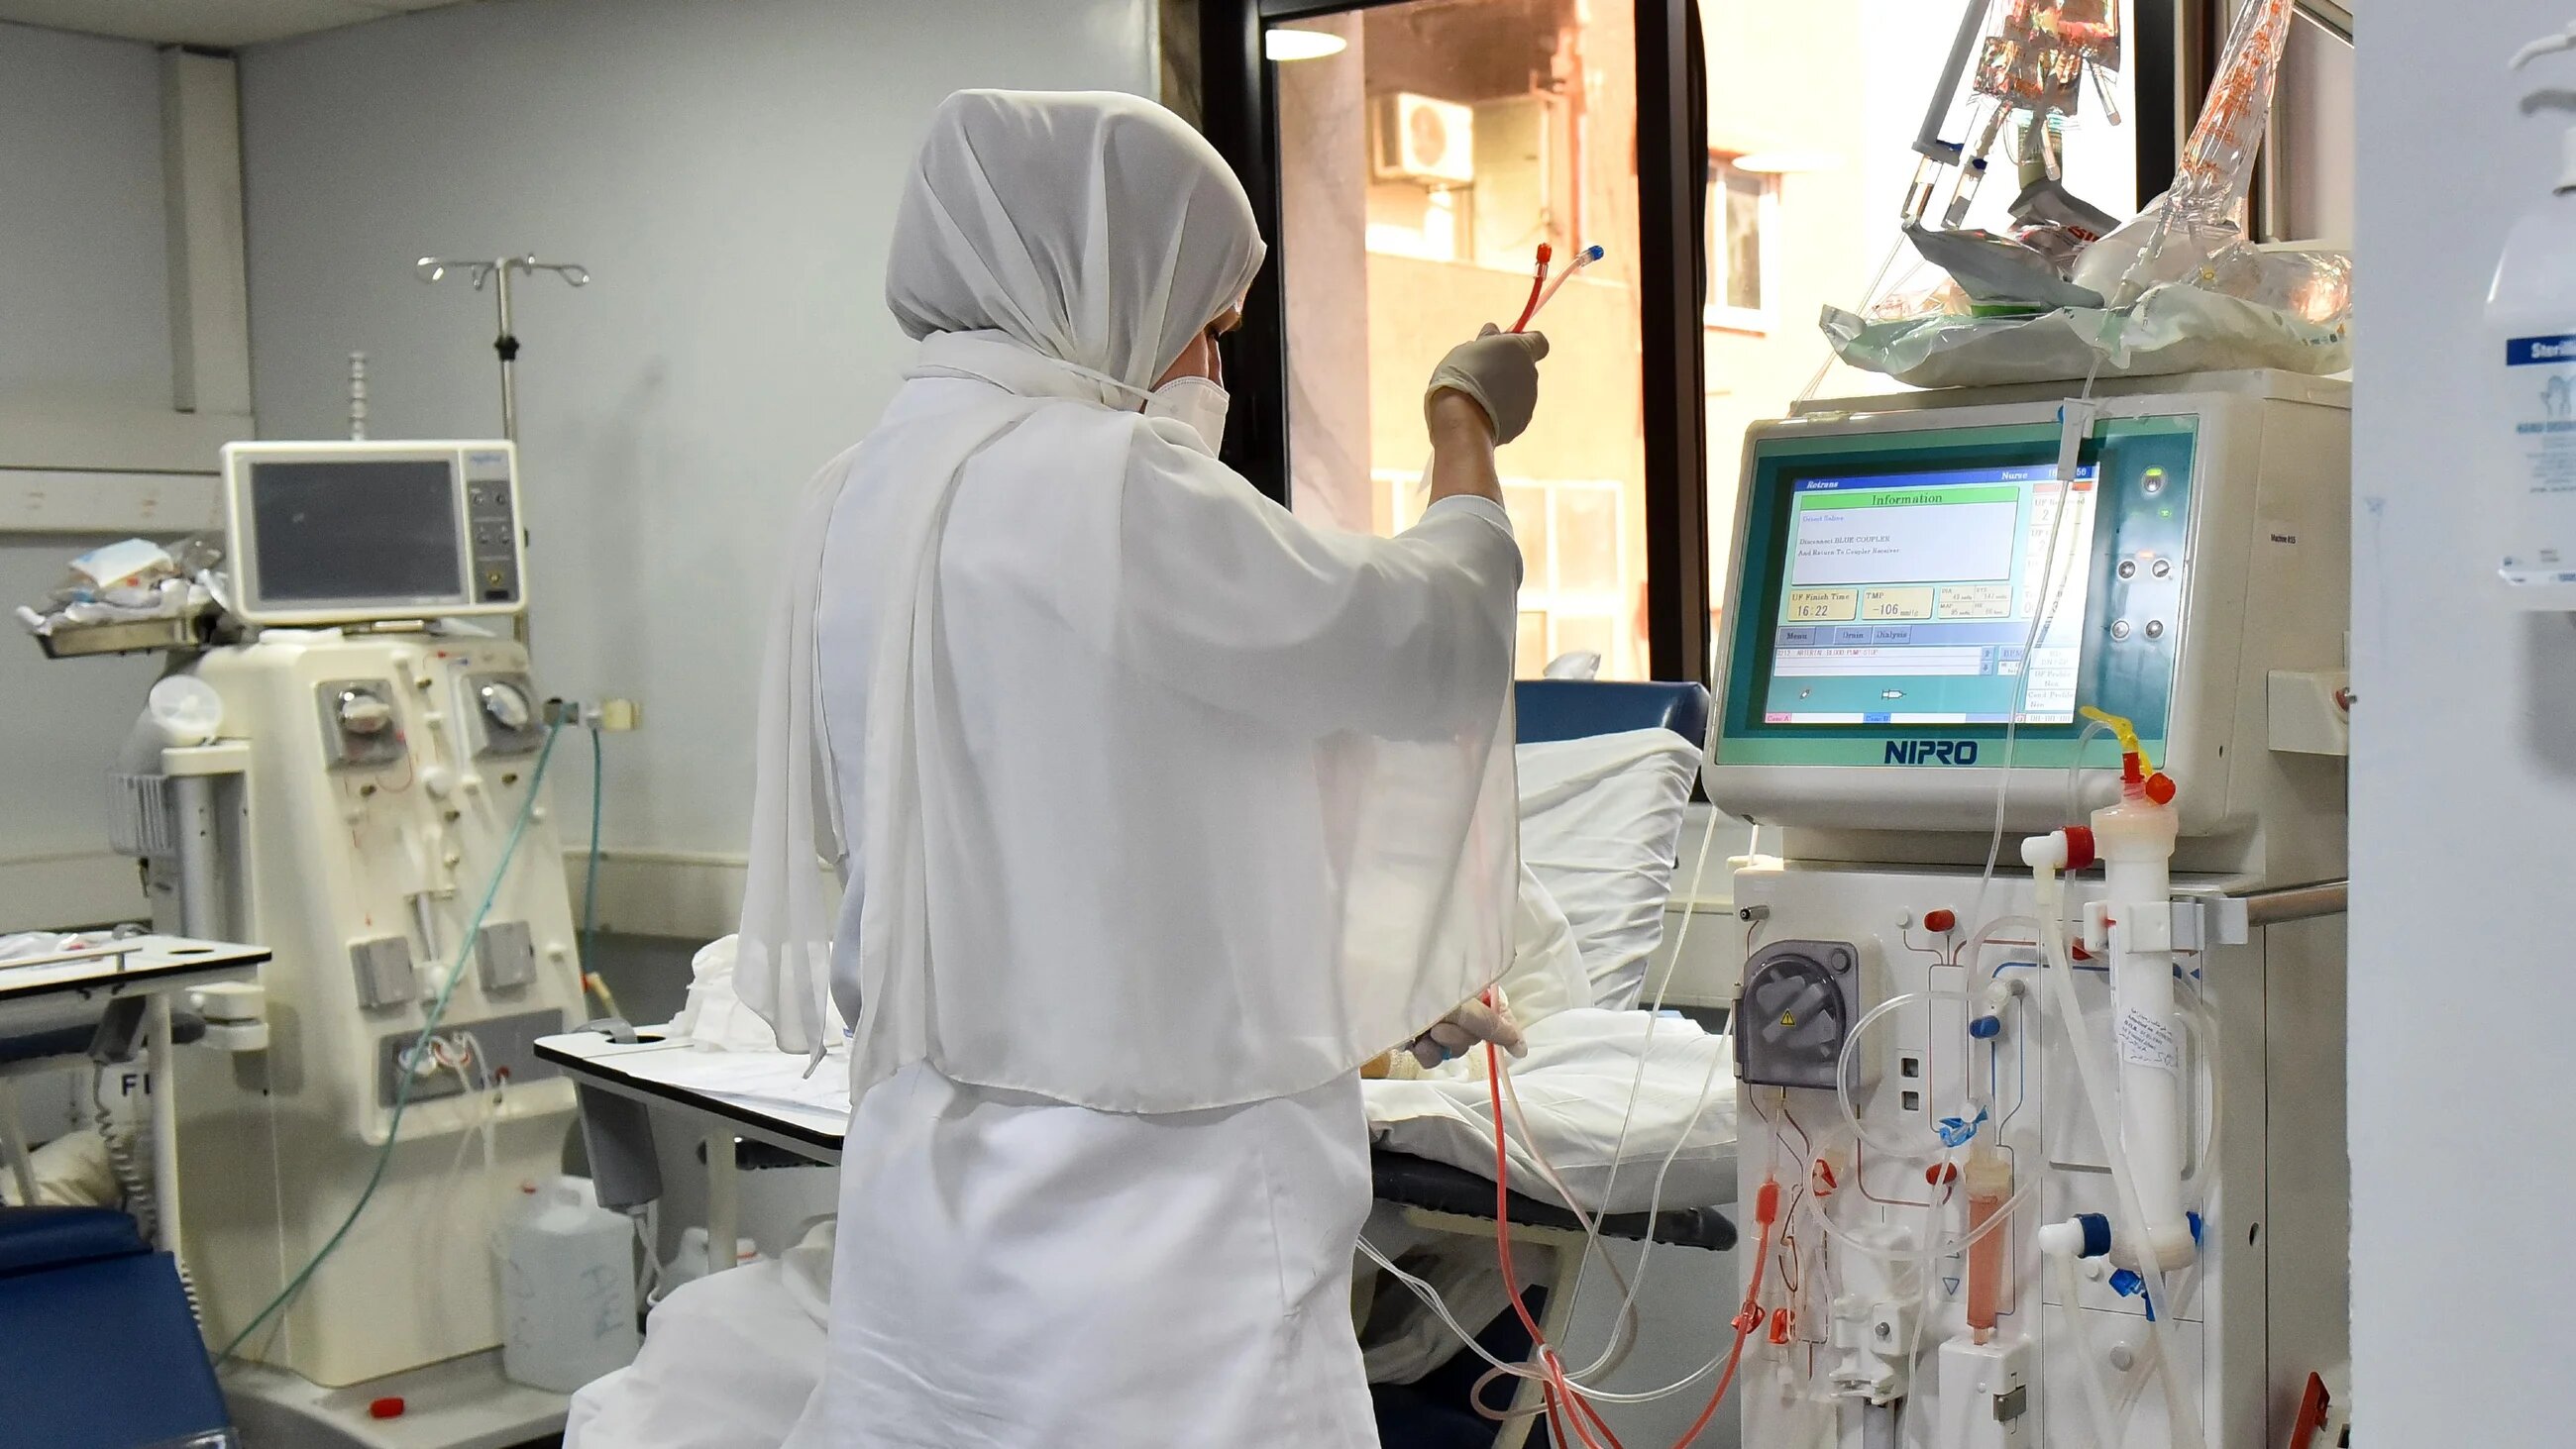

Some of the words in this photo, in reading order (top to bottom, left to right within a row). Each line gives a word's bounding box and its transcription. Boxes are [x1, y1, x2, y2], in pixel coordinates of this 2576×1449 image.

[1806, 480, 1839, 489] Retrans
[1872, 494, 1943, 506] Information
[1805, 592, 1829, 601] Finish
[1831, 592, 1850, 601] Time
[1866, 591, 1884, 600] TMP
[1797, 605, 1828, 617] 16:22
[1873, 603, 1898, 616] -106
[1877, 630, 1907, 640] Dialysis
[1884, 741, 1978, 765] NIPRO
